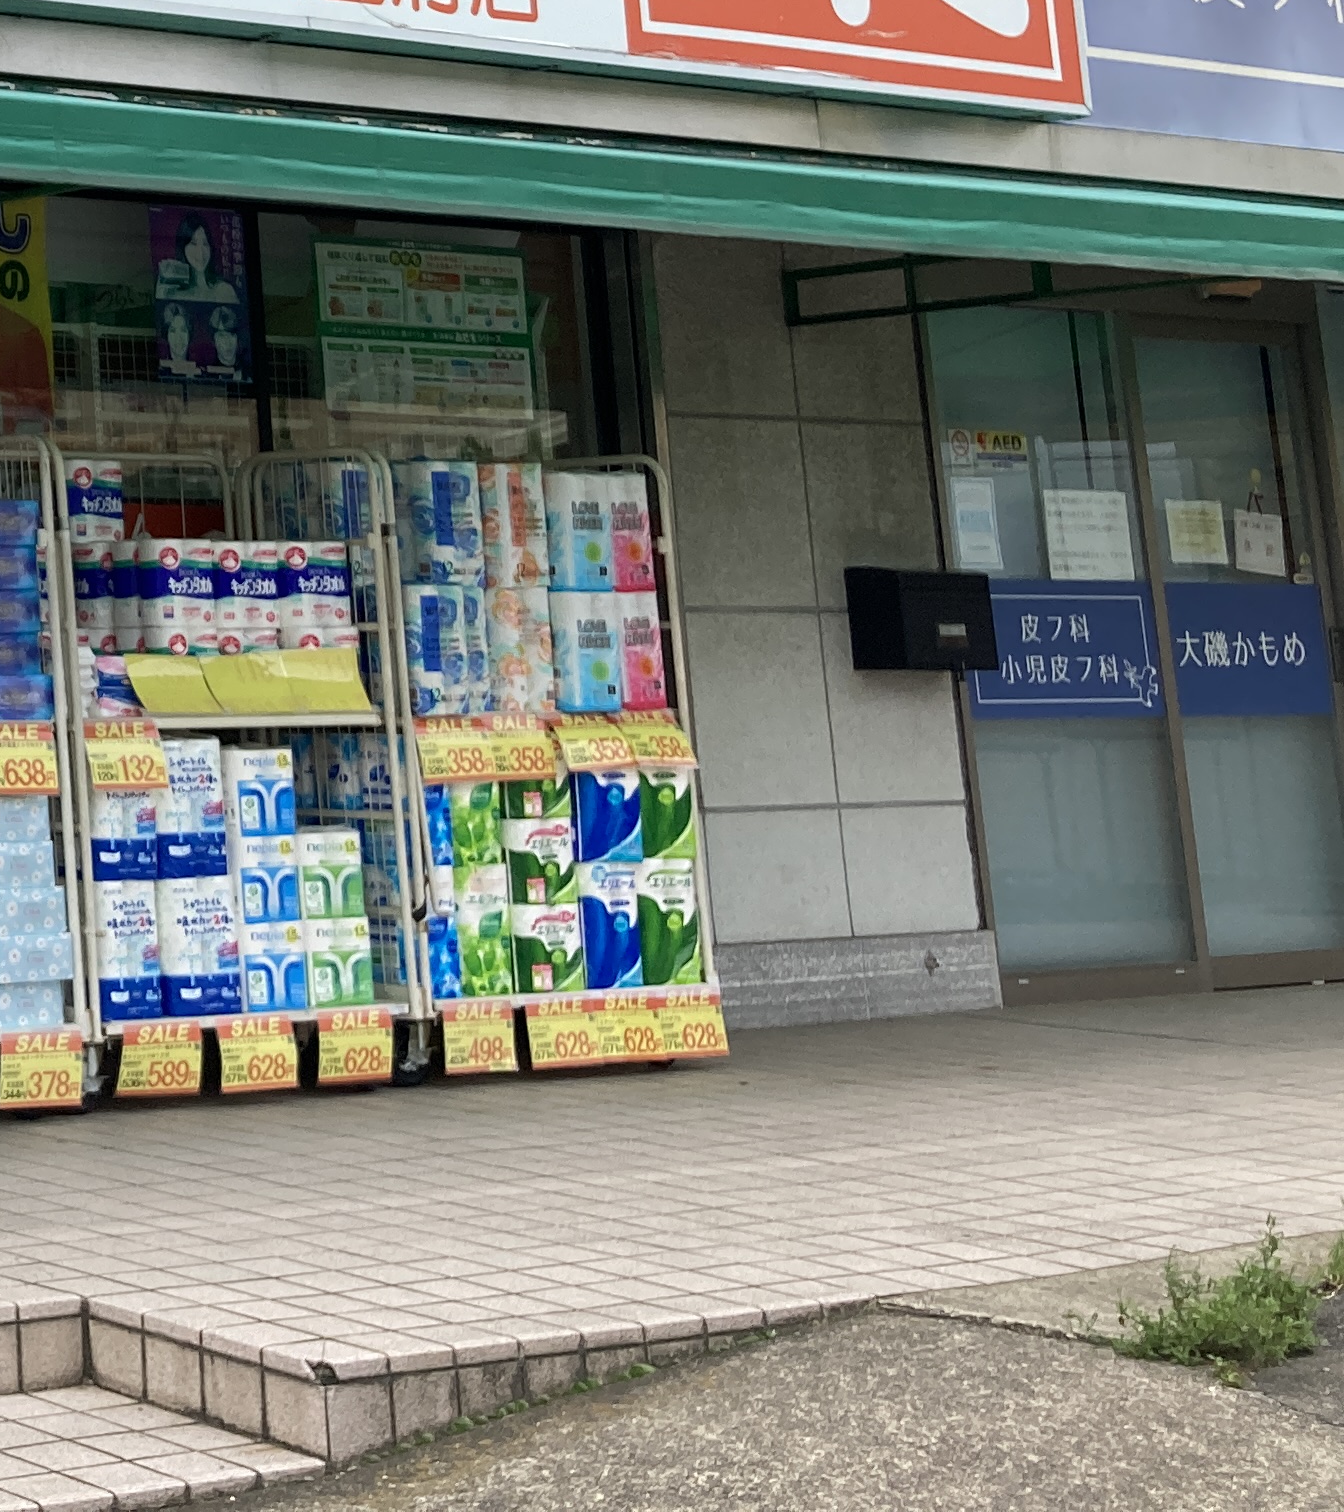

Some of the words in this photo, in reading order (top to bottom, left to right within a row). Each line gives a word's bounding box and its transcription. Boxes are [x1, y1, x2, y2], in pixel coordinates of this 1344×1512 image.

[991, 434, 1022, 452] AED
[1020, 613, 1090, 645] 皮フ科
[1175, 630, 1307, 669] 大磯かもめ
[1000, 654, 1120, 686] 小児皮フ科
[425, 718, 473, 732] SALE
[491, 714, 537, 731] SALE
[562, 713, 609, 726] SALE
[620, 711, 667, 724] SALE
[94, 721, 145, 738] SALE
[538, 998, 583, 1016] SALE
[604, 994, 649, 1011] SALE
[665, 990, 711, 1007] SALE
[330, 1010, 380, 1030] SALE
[455, 1003, 503, 1021] SALE
[137, 1023, 190, 1044] SALE
[230, 1016, 281, 1037] SALE
[15, 1032, 71, 1053] SALE
